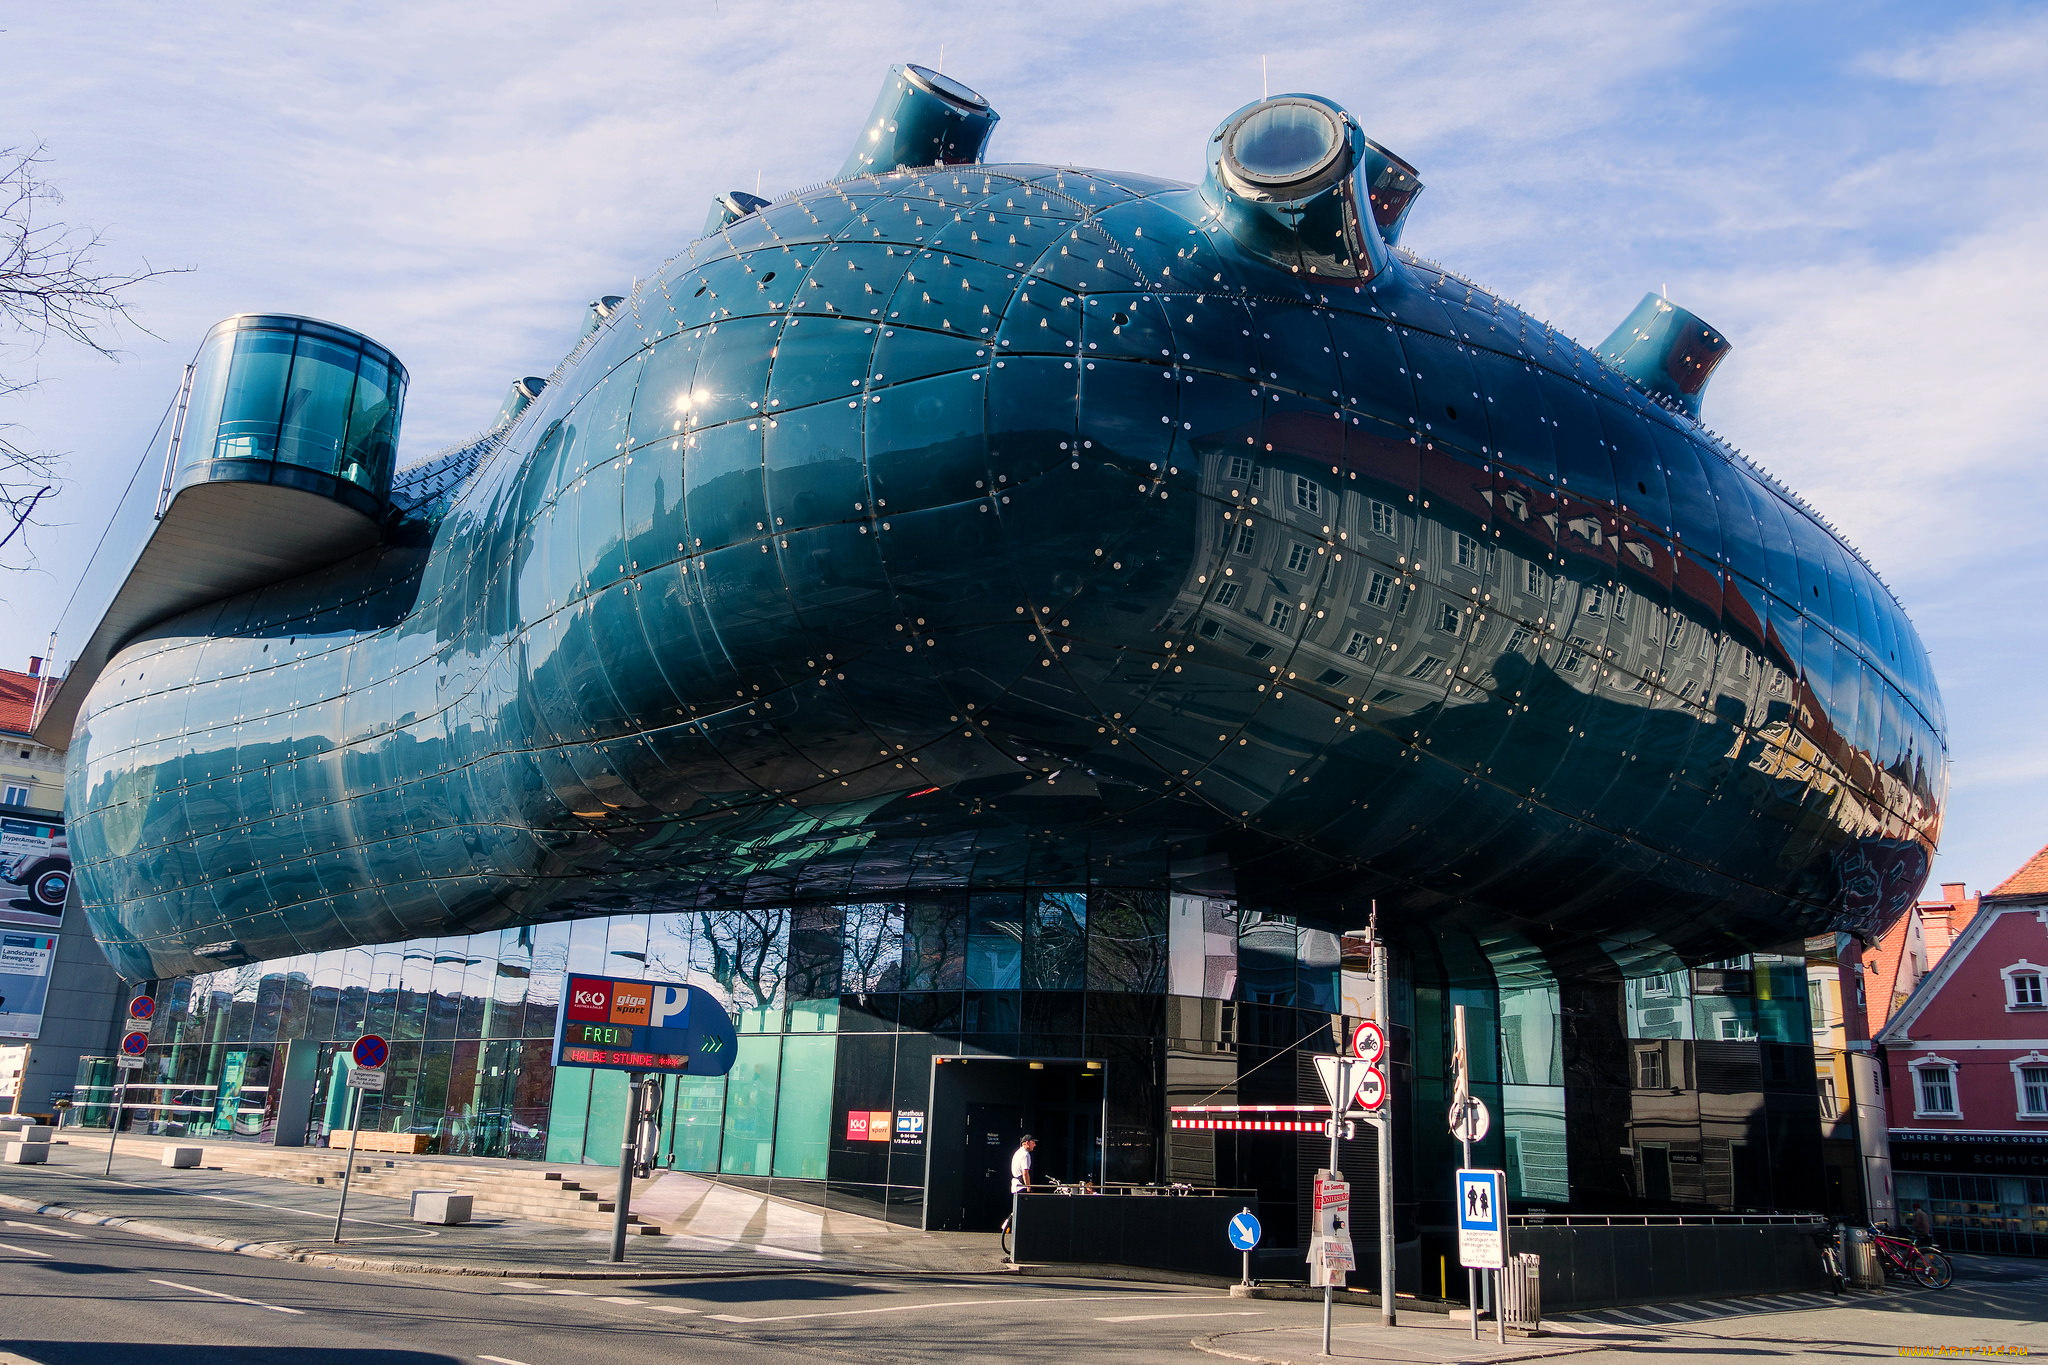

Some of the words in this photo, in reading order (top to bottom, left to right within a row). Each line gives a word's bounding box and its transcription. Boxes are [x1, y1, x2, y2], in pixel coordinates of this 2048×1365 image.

[3, 834, 46, 845] HyperAmerika
[3, 948, 38, 957] Landschaft
[2, 954, 35, 963] Bewegung
[574, 990, 605, 1006] K&O
[616, 994, 647, 1007] giga
[616, 1006, 645, 1014] sport
[650, 985, 689, 1027] P
[584, 1027, 619, 1044] FREI
[571, 1050, 607, 1063] HALBE
[612, 1053, 653, 1066] STUNDE
[1954, 1135, 2007, 1143] SCHMUCK
[1901, 1152, 1952, 1162] UHREN
